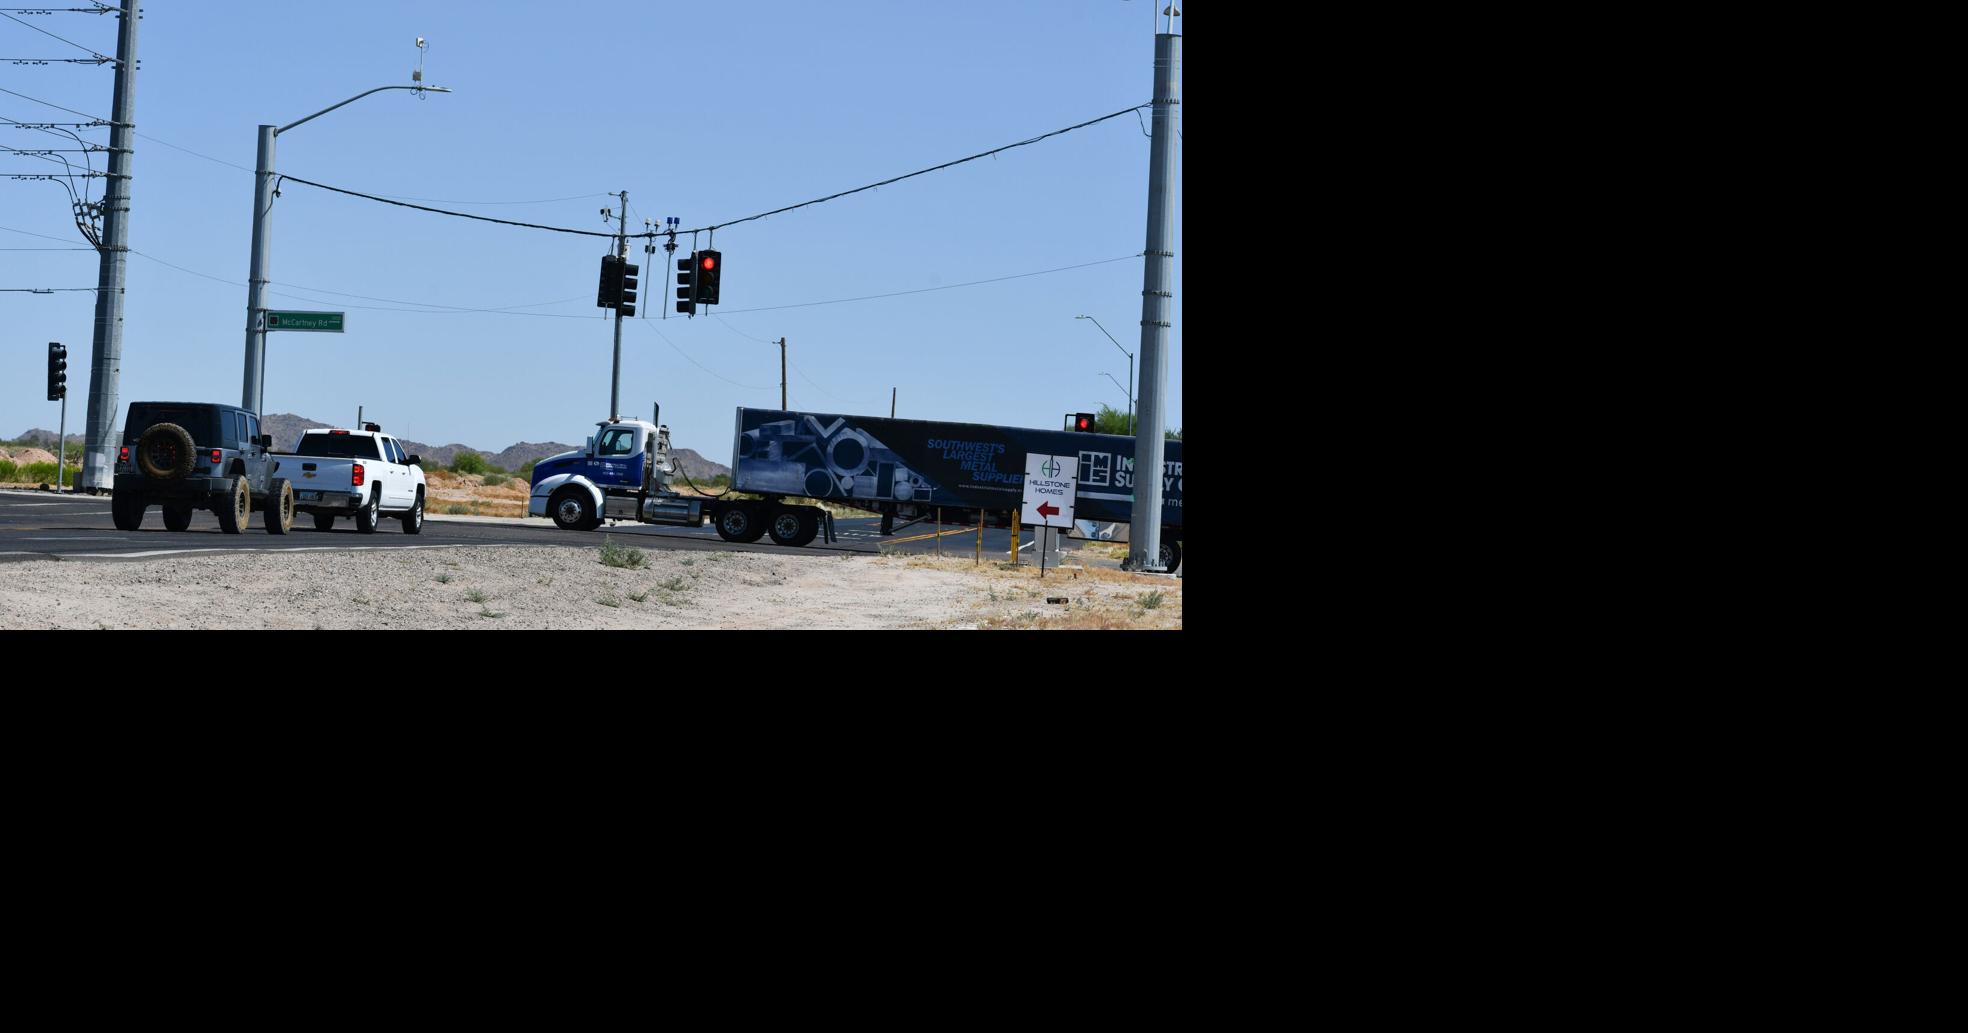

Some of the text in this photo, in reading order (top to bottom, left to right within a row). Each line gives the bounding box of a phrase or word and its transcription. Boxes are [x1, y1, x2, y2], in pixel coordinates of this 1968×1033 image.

[282, 318, 328, 328] McCartney Rd
[927, 439, 1006, 454] SOUTHWEST'S
[943, 449, 994, 463] LARGEST
[960, 460, 999, 473] METAL
[1029, 480, 1071, 489] HILLSTONE
[1035, 488, 1064, 496] HOMES
